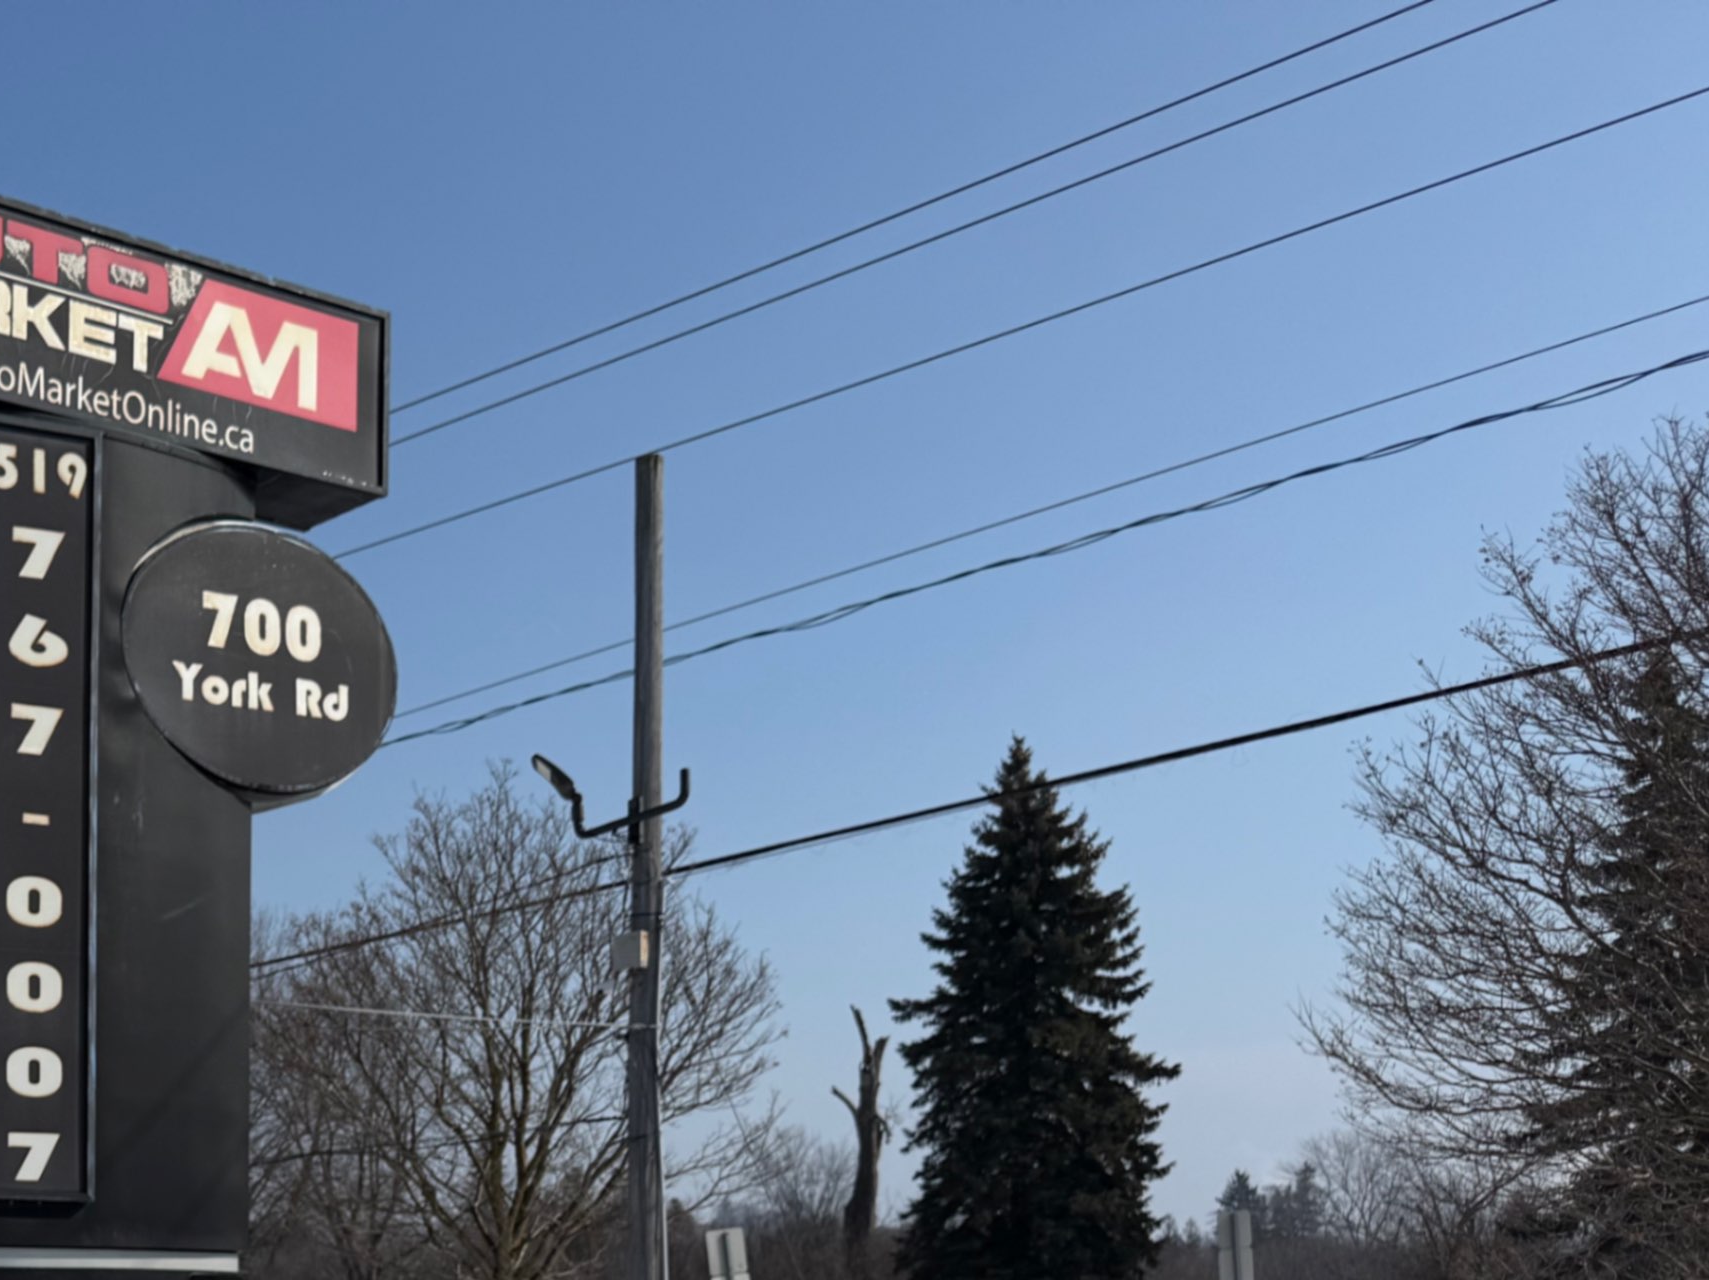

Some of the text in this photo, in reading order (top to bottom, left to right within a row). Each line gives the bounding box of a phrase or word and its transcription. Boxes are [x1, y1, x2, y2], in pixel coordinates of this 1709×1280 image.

[181, 300, 319, 412] AM
[201, 589, 323, 663] 700
[172, 659, 350, 722] York Rd
